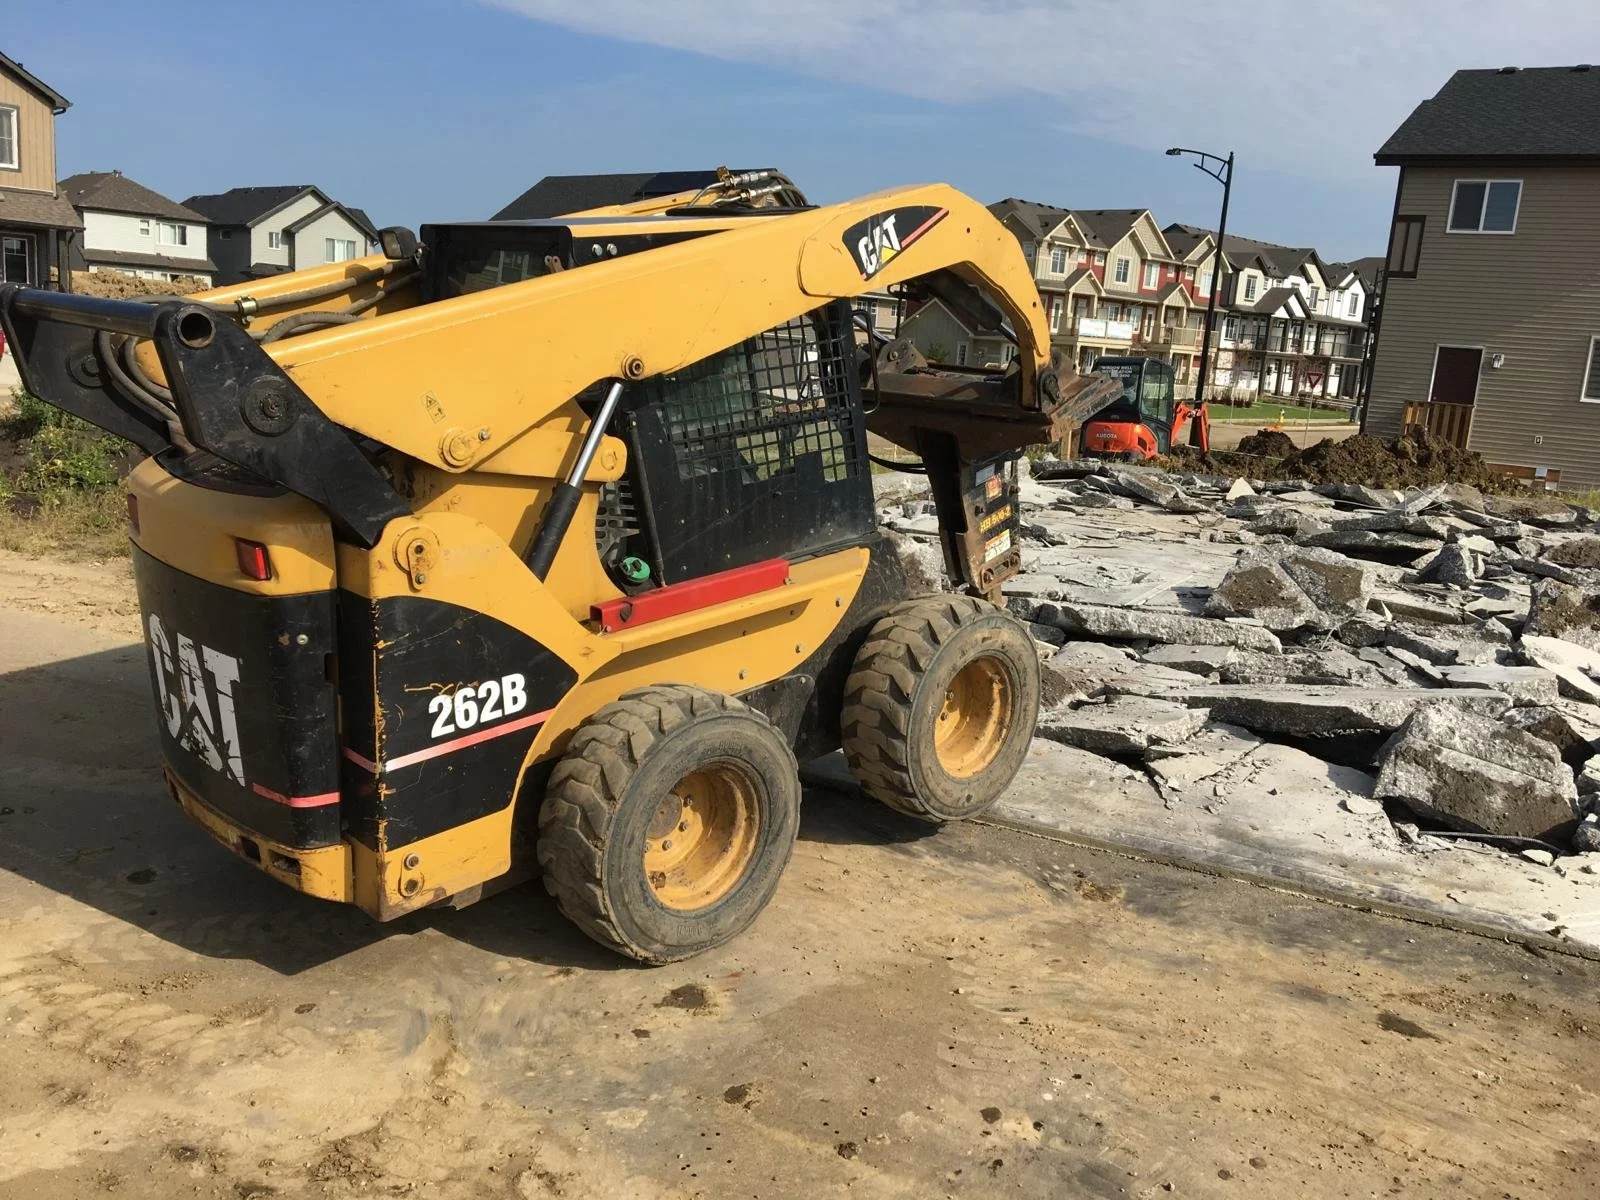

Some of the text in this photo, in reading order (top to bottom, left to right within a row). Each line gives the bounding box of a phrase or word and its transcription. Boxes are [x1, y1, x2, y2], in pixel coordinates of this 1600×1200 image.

[858, 213, 901, 274] CAT
[149, 613, 246, 788] CAT
[428, 673, 528, 739] 262B
